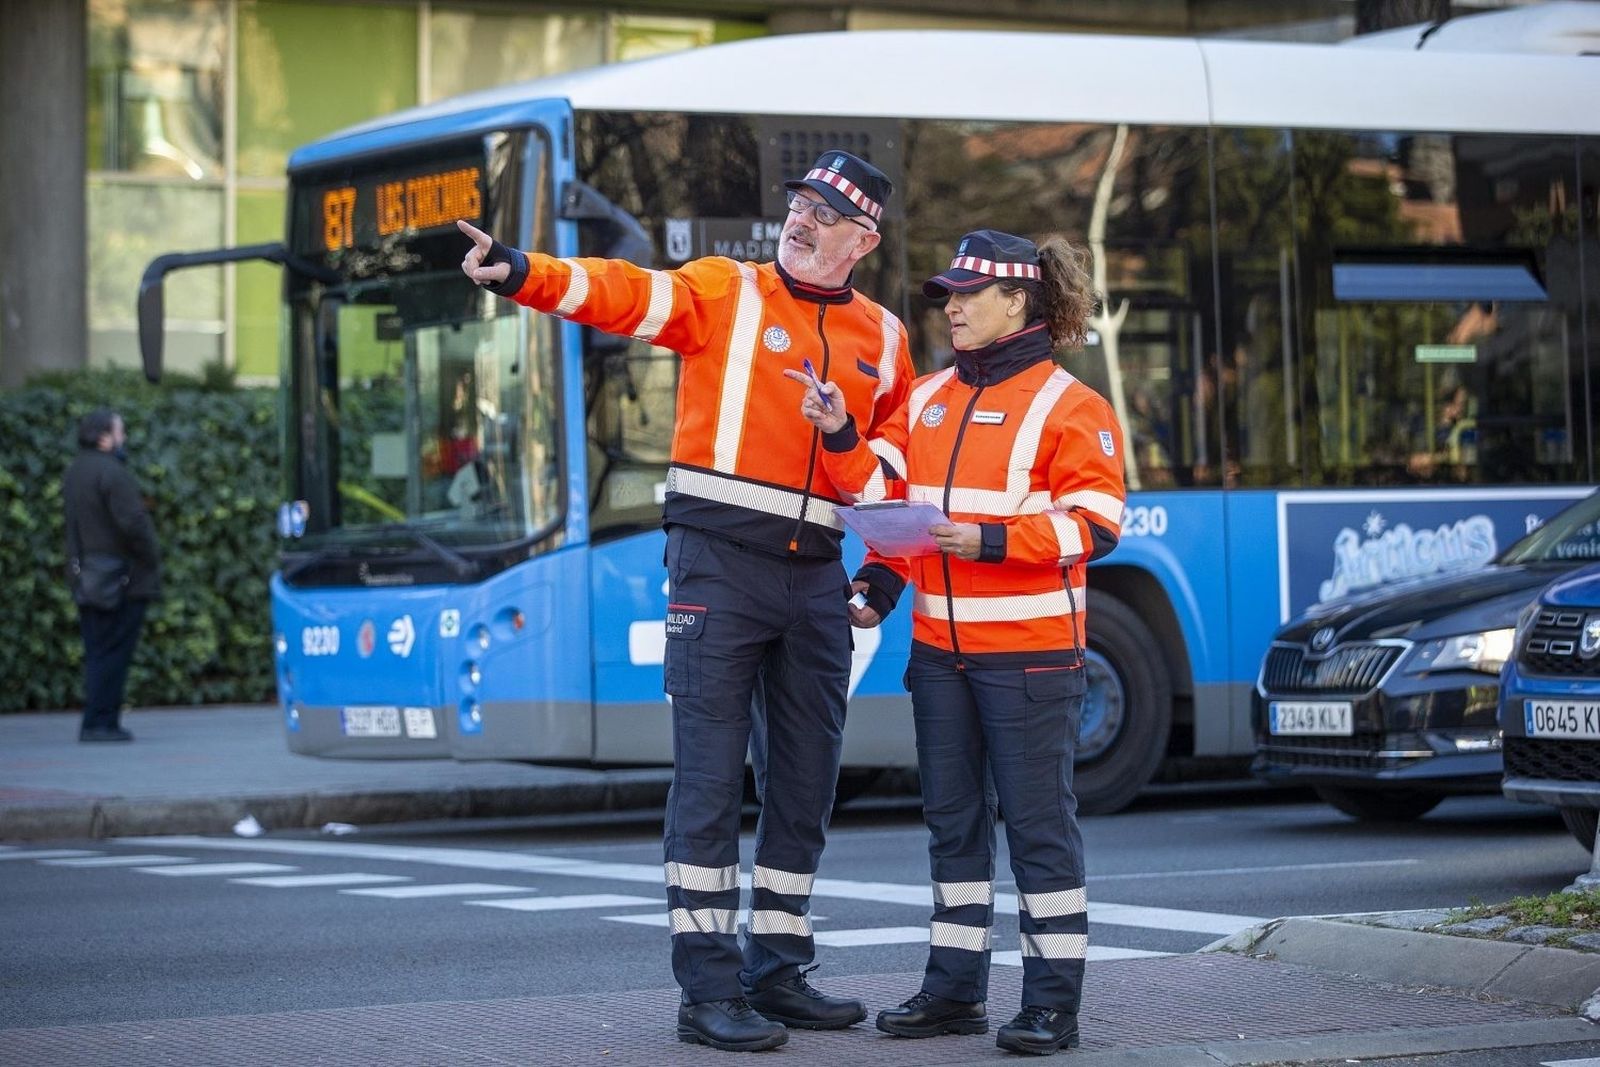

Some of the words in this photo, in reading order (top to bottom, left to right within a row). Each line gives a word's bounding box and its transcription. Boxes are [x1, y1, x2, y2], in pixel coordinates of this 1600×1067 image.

[323, 187, 357, 251] 87
[752, 222, 782, 240] EM
[714, 239, 780, 258] MADR
[1121, 506, 1168, 537] 230
[1280, 707, 1315, 730] 2349
[1319, 706, 1345, 730] KLY
[1535, 705, 1578, 732] 0645
